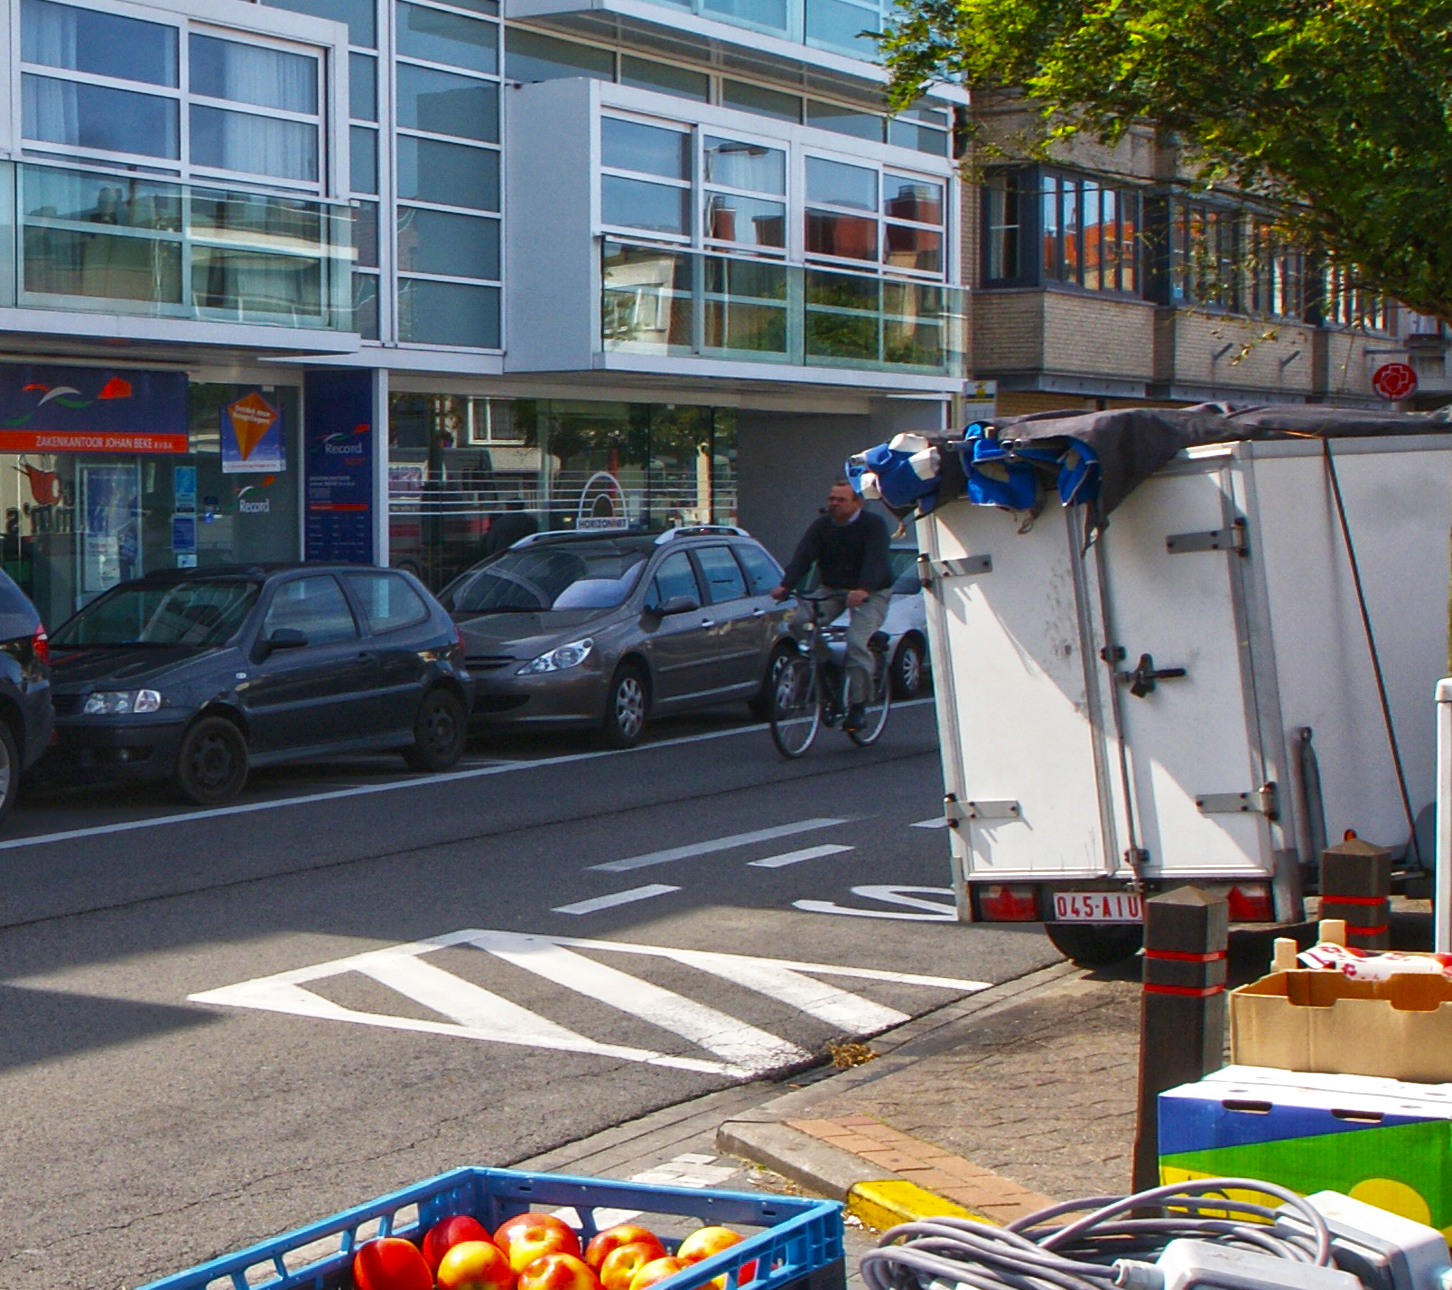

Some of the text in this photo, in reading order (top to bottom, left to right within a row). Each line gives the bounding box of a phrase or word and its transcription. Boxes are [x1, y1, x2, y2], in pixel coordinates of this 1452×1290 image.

[35, 435, 104, 448] ZAKENKANTOOR
[105, 436, 132, 449] JOHAN
[133, 437, 153, 449] BEKE
[324, 442, 364, 455] Record
[239, 498, 270, 514] Record
